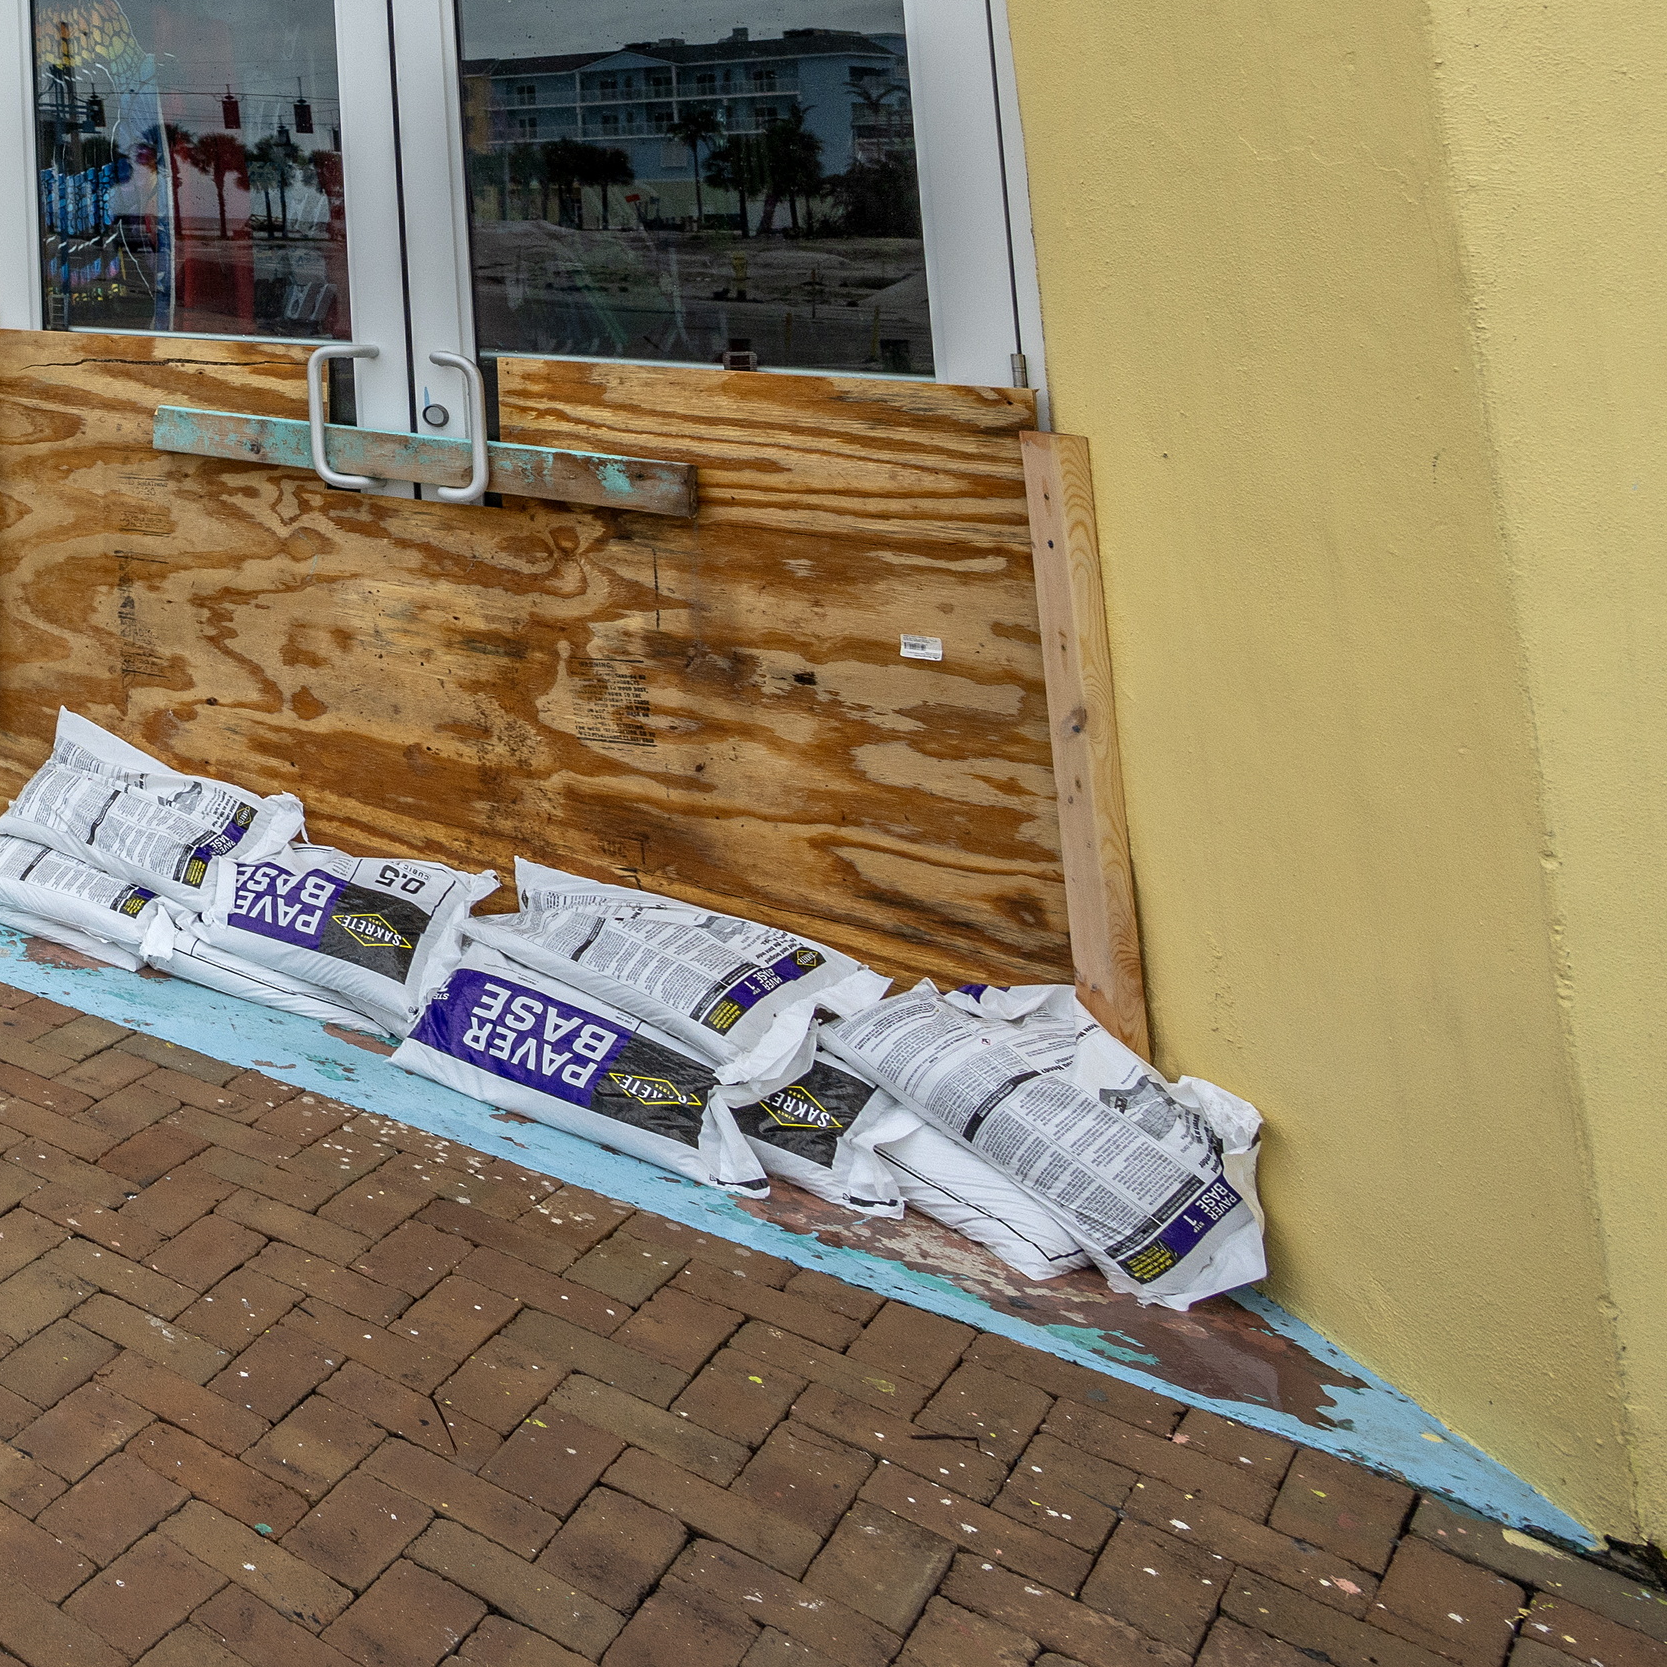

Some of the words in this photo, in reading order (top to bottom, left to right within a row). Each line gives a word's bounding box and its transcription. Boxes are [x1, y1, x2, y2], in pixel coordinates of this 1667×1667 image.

[375, 865, 425, 894] 0.5
[404, 865, 430, 880] CUBIC
[234, 891, 323, 935] PAVE
[340, 915, 402, 946] SAKRETE
[472, 983, 618, 1061] BASE
[463, 1017, 598, 1089] PAVER
[1195, 1182, 1228, 1217] BASE
[1210, 1193, 1237, 1221] PAVER
[1182, 1215, 1197, 1226] 1
[1194, 1221, 1205, 1233] STEP
